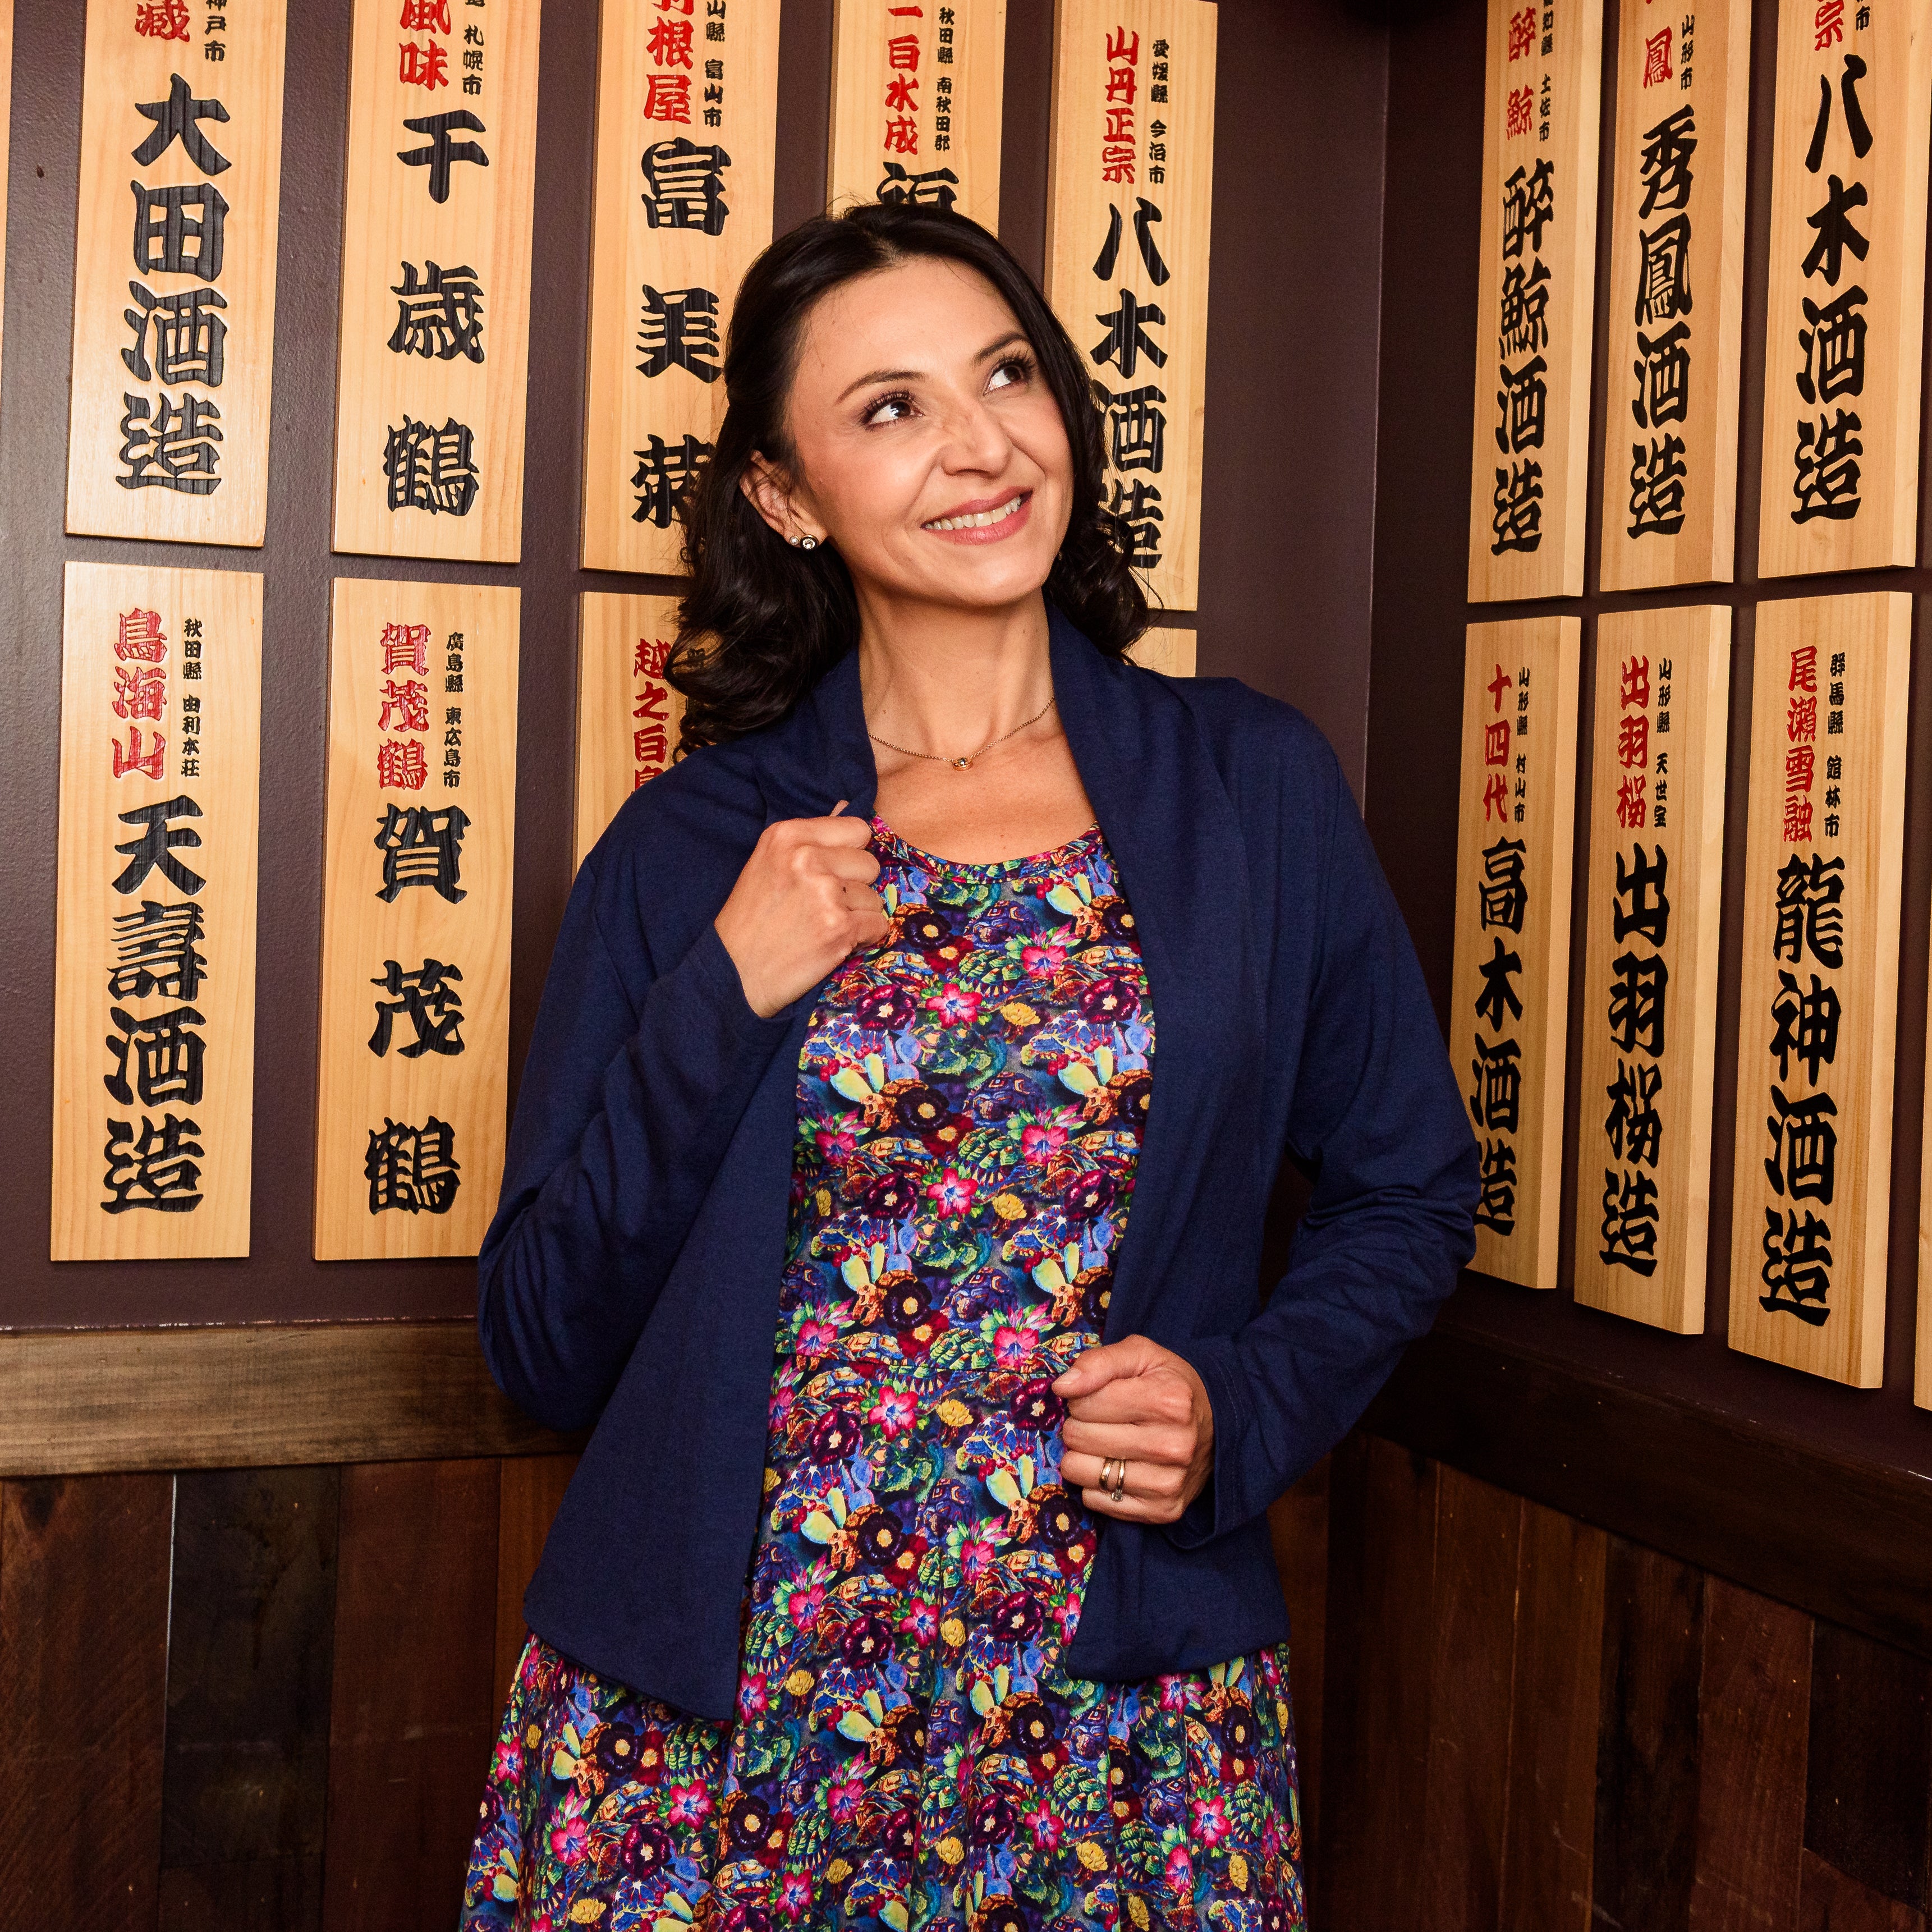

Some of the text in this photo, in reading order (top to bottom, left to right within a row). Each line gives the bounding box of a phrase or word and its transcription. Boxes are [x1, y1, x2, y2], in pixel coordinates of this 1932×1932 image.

[462, 25, 484, 95] 札幌市
[1103, 27, 1139, 183] 山丹正宗
[1541, 0, 1554, 56] 知縣
[1681, 15, 1695, 90] 山形市
[1149, 120, 1167, 183] 今治市
[116, 74, 232, 495] 大田酒造
[383, 109, 489, 516] 千歳鶴
[1627, 104, 1697, 539] 秀鳳酒造
[1791, 54, 1873, 524] 八木酒造
[112, 609, 165, 779] 鳥海山
[181, 695, 200, 777] 由利本荘
[378, 625, 429, 790] 賀茂鶴
[443, 706, 462, 788] 東広島市
[1483, 663, 1512, 823] 十四代
[1515, 754, 1526, 823] 村山市
[100, 795, 208, 1214] 天壽酒造
[364, 803, 471, 1215] 賀茂鶴
[1470, 836, 1529, 1237] 高木酒造
[1759, 853, 1845, 1327] 龍神酒造
